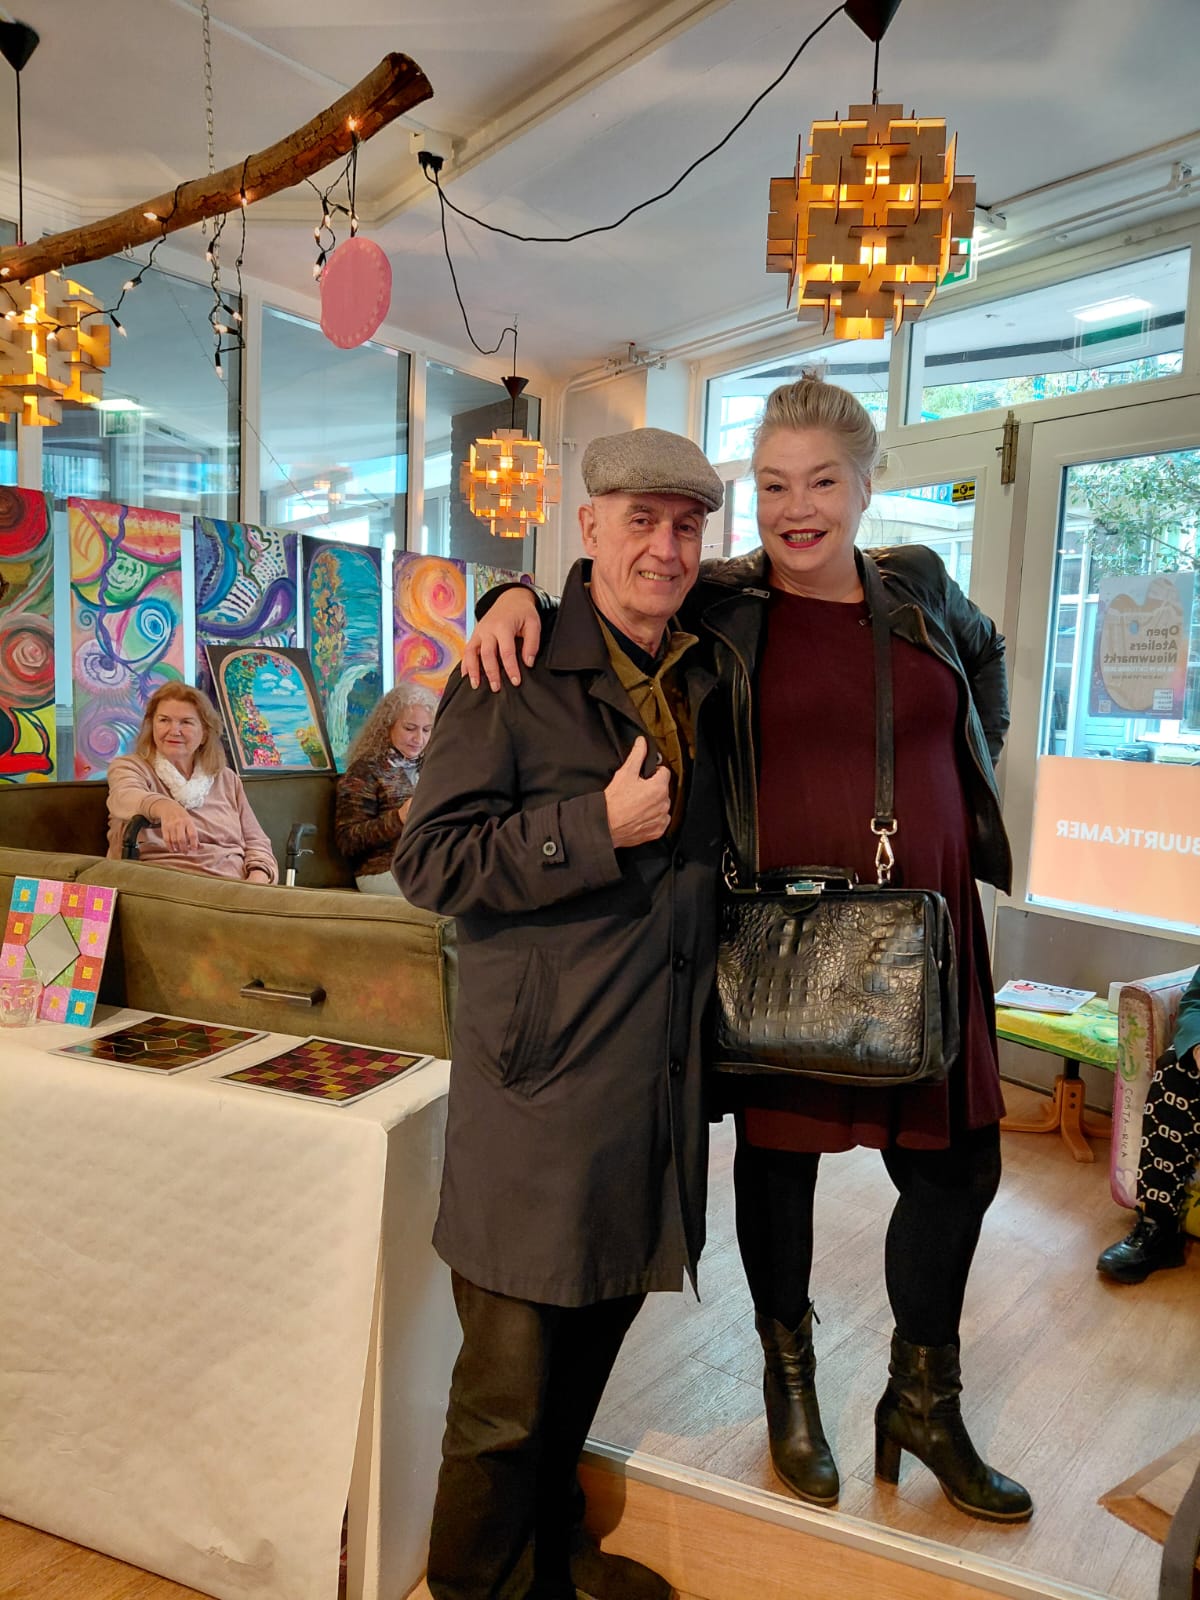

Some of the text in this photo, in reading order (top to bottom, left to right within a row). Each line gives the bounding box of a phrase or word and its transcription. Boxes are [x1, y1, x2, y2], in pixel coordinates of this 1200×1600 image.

[1164, 1091, 1189, 1111] GD
[1158, 1124, 1182, 1143] GD
[1153, 1157, 1175, 1173] GD
[1146, 1188, 1171, 1204] GD
